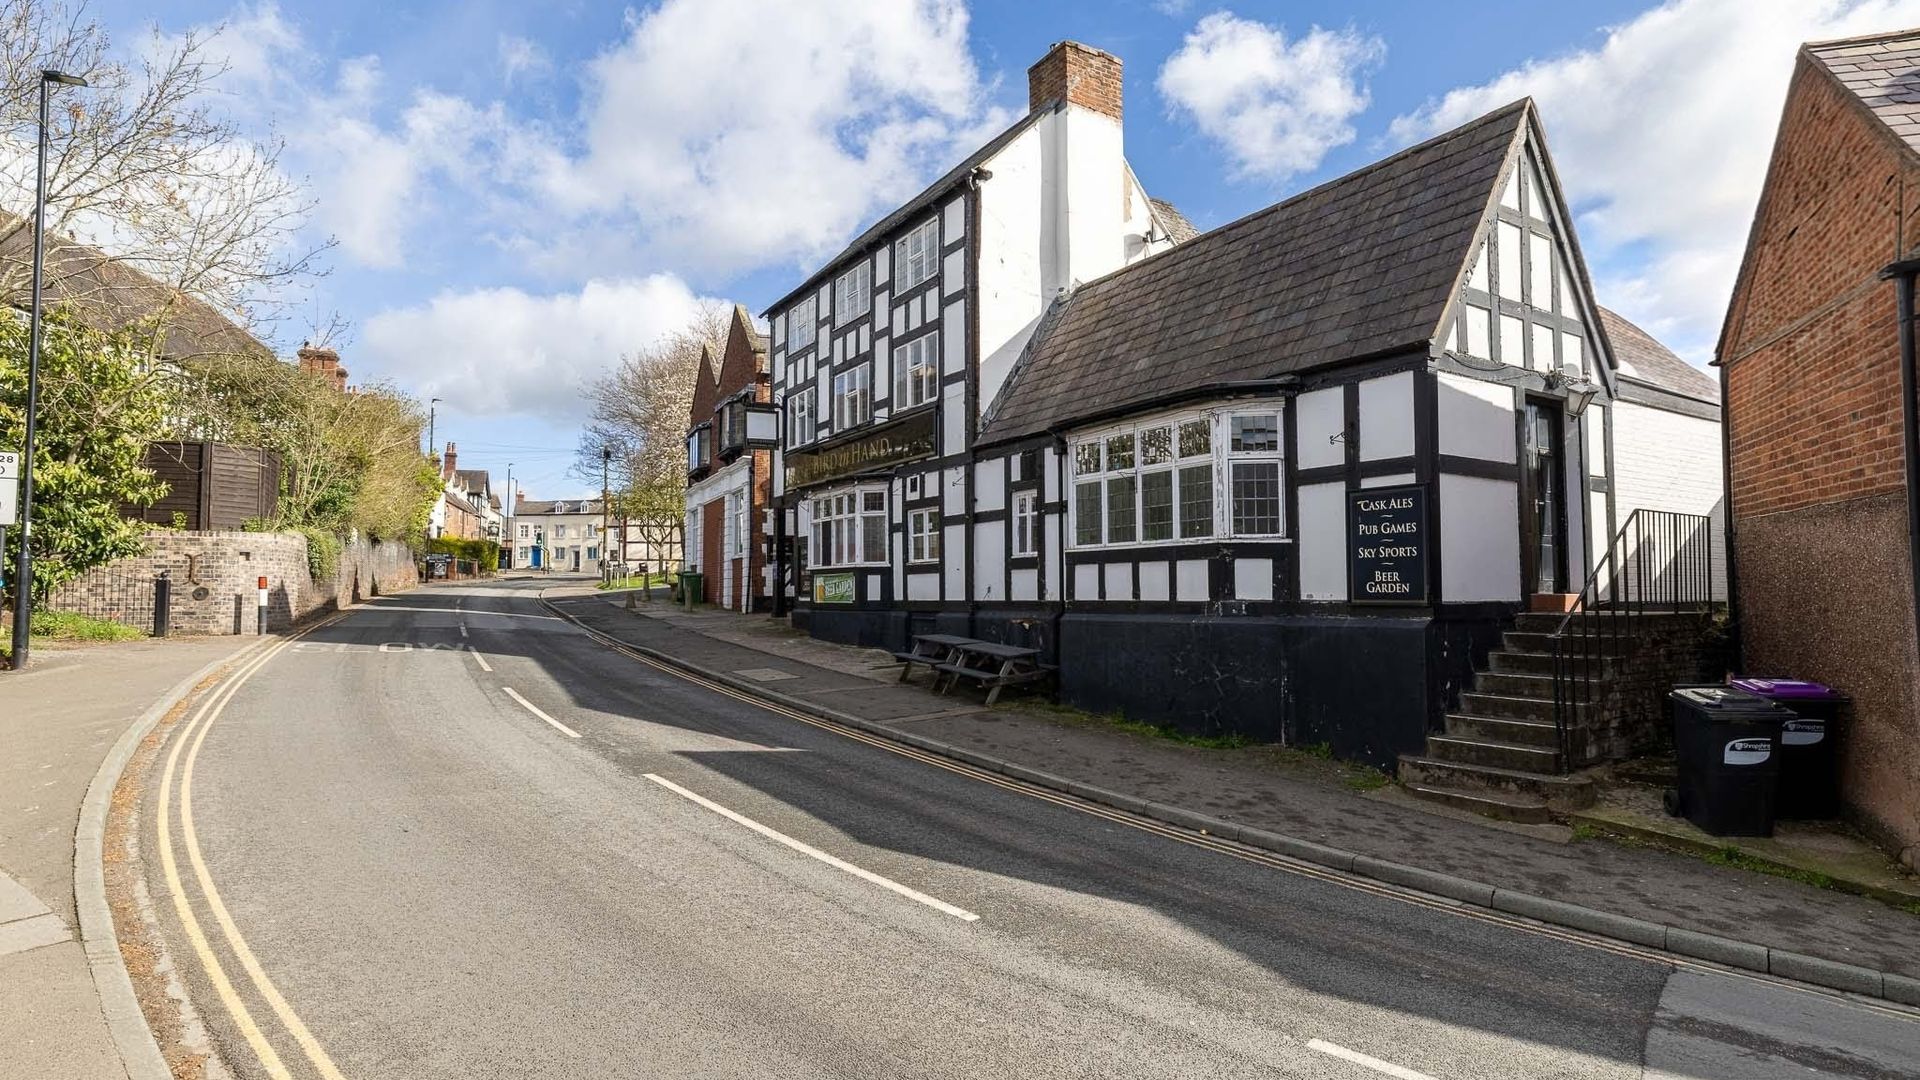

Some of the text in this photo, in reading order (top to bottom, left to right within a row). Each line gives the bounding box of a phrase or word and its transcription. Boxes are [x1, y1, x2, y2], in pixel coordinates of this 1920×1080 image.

[850, 438, 890, 464] HAND
[1359, 498, 1413, 511] CASK ALES
[1359, 522, 1417, 535] PUB GAMES
[1358, 546, 1417, 559] SKY SPORTS
[1375, 571, 1400, 582] BEER
[1366, 582, 1410, 593] GARDEN
